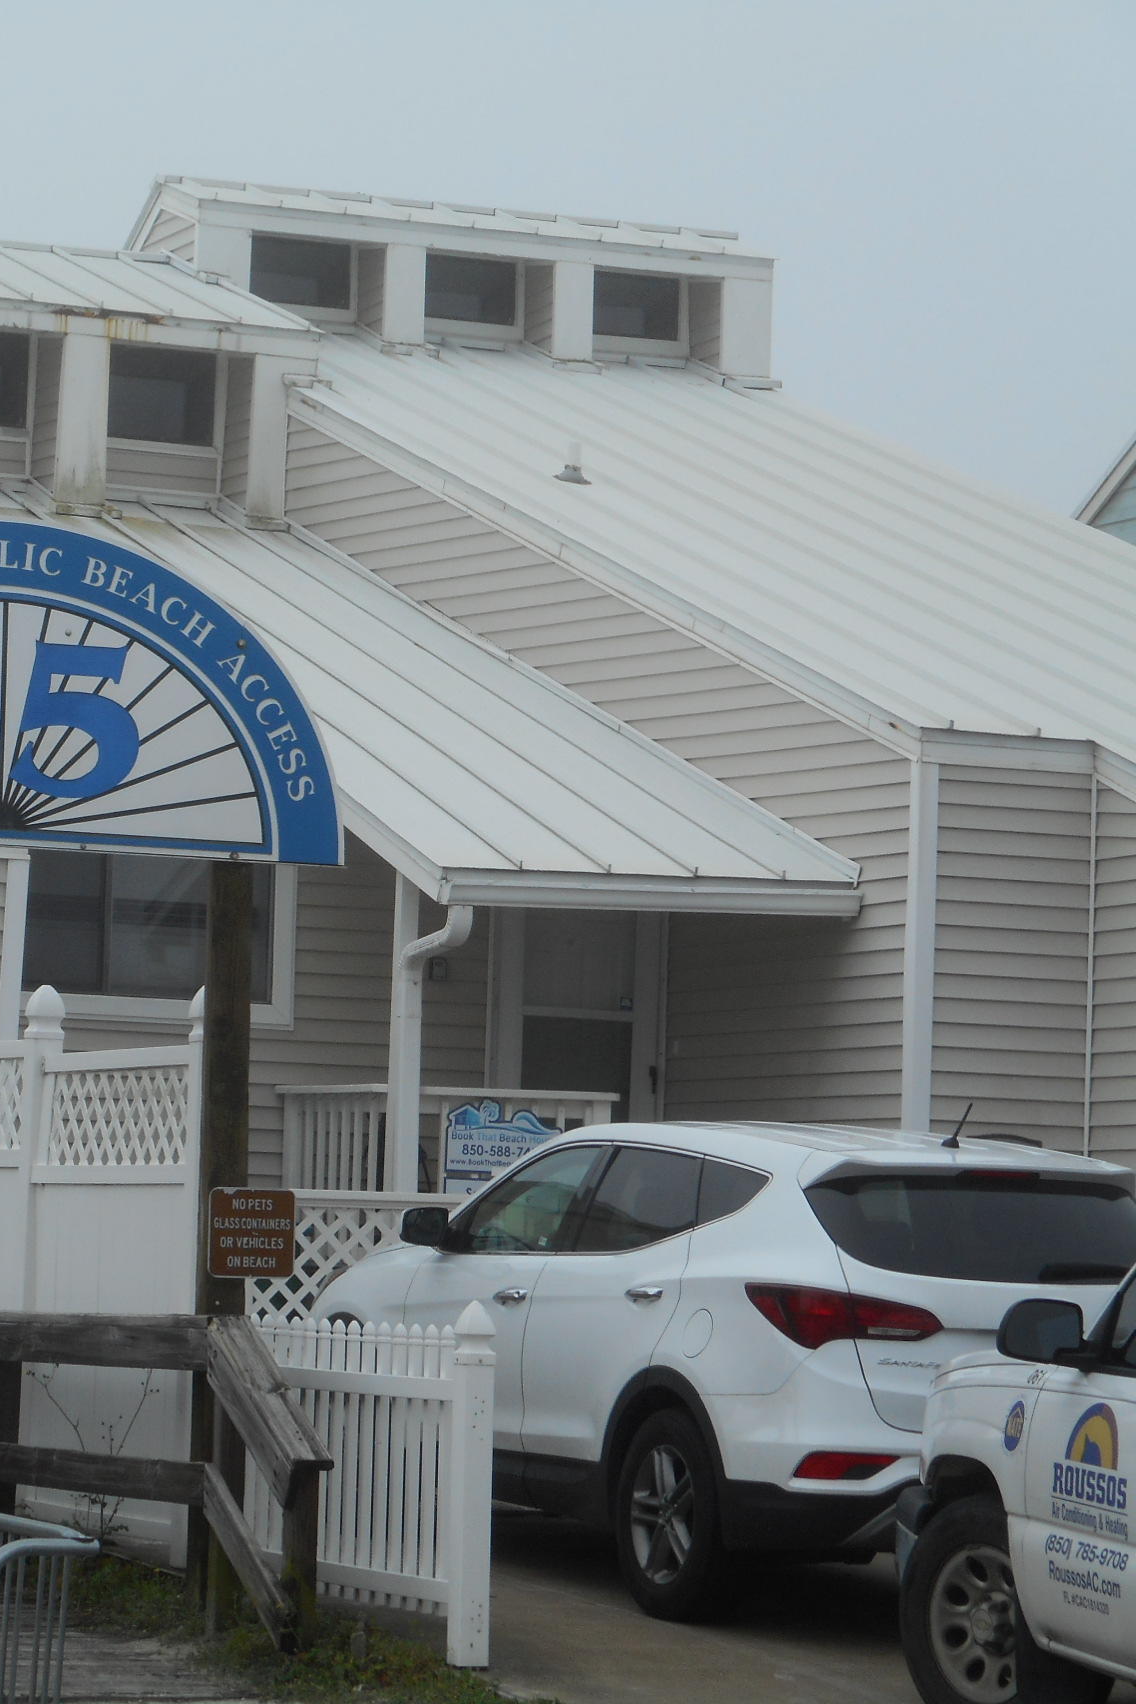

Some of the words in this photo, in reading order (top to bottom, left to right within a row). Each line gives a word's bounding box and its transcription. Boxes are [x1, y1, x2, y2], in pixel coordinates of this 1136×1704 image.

[81, 556, 216, 649] BEACH
[219, 652, 315, 802] ACCESS
[452, 1131, 474, 1140] Book
[478, 1132, 496, 1142] That
[499, 1134, 527, 1143] Beach
[232, 1199, 246, 1210] NO
[248, 1199, 273, 1210] PETS
[214, 1217, 240, 1228] GLASS
[241, 1218, 291, 1230] CONTAINERS
[220, 1237, 233, 1248] OR
[236, 1237, 284, 1249] VEHICLES
[227, 1256, 241, 1267] ON
[243, 1257, 276, 1268] BEACH
[1052, 1462, 1128, 1510] ROUSSOS
[1052, 1501, 1060, 1520] Air
[1062, 1503, 1097, 1532] Conditioning
[1098, 1514, 1103, 1530] &
[1105, 1515, 1129, 1542] Heating
[1045, 1534, 1073, 1560] (850)
[1075, 1542, 1129, 1571] 785-9708
[1049, 1560, 1121, 1599] RoussosAC.com
